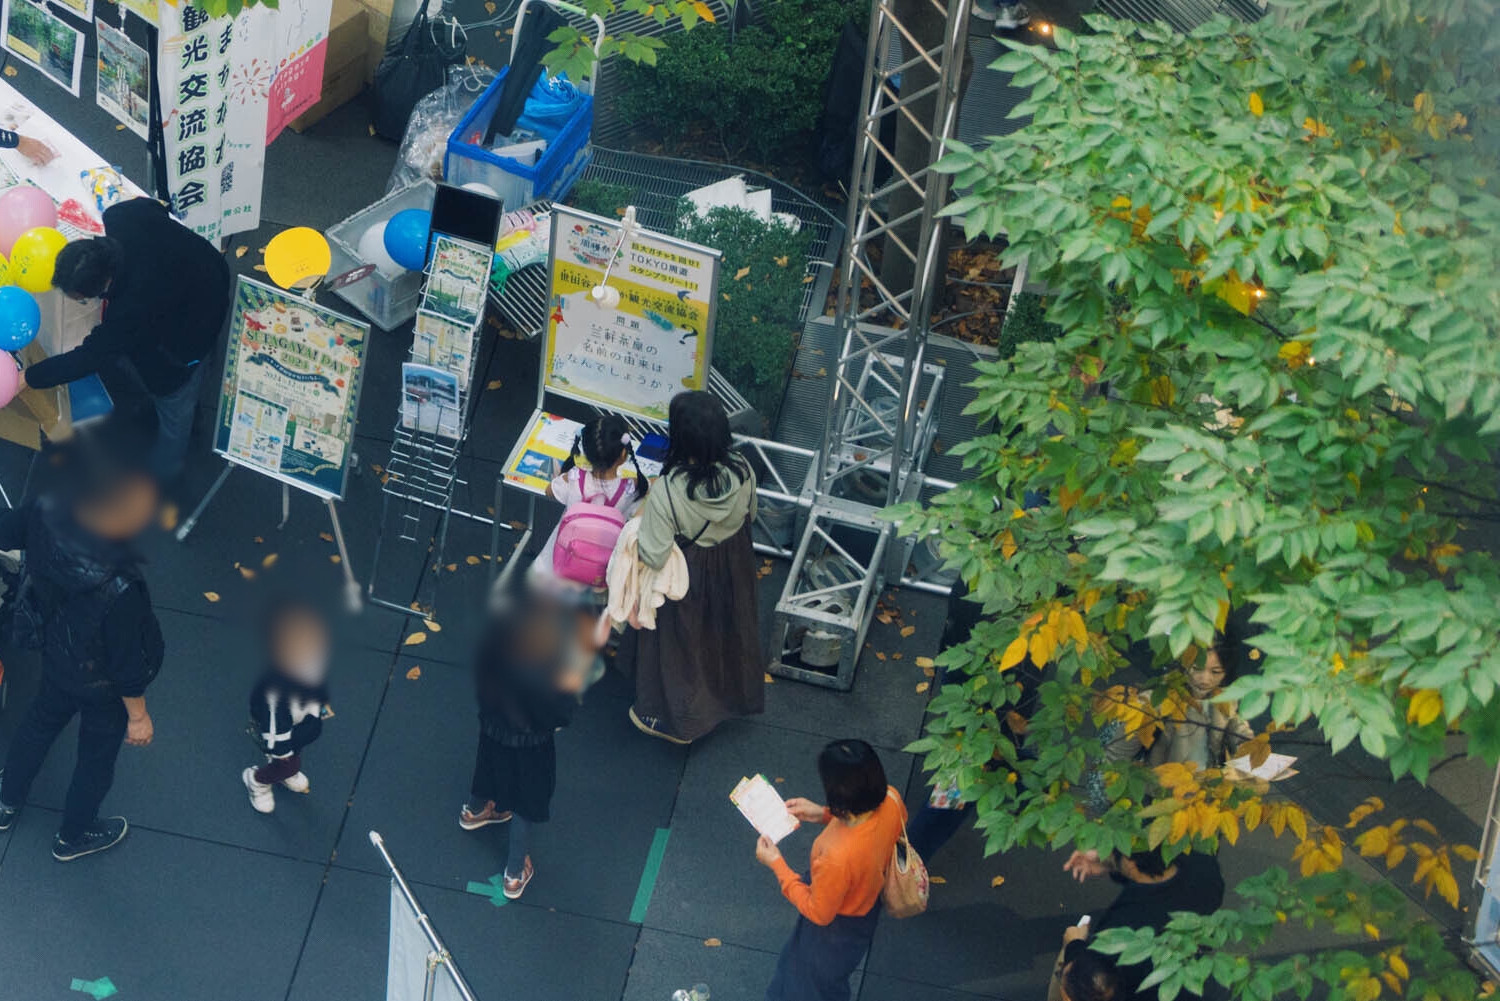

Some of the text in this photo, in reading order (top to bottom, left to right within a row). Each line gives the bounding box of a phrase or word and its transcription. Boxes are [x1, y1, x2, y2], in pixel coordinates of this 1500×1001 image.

[178, 5, 210, 211] 観光交流協会
[615, 315, 641, 330] 問題
[591, 327, 659, 356] 三軒茶屋の
[582, 342, 664, 374] 名前の由来は
